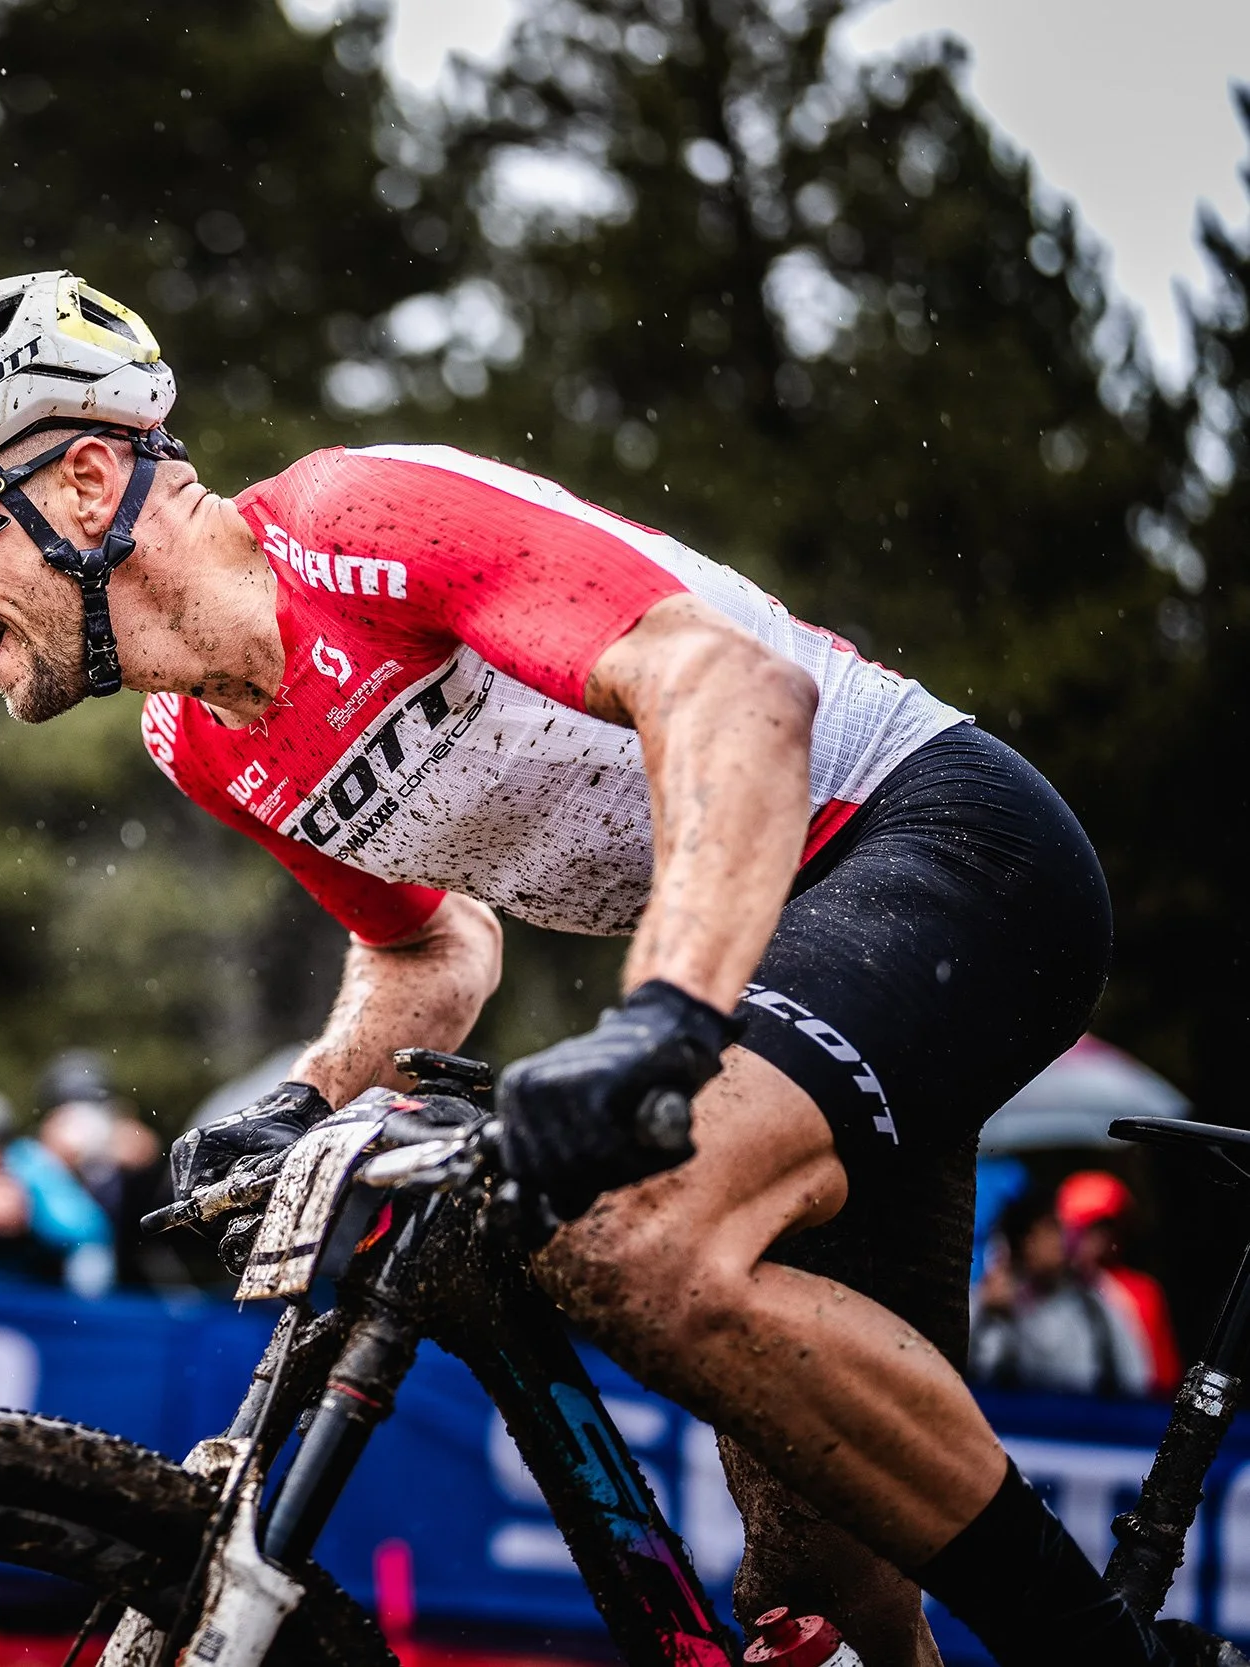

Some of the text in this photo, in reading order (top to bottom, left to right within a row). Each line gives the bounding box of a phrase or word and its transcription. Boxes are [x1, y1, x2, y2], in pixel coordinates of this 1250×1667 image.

[263, 523, 408, 600] SRAM
[326, 706, 339, 720] UCI
[329, 659, 398, 728] MOUNTAIN BIKE
[335, 665, 404, 731] WORLD SERIES
[230, 759, 269, 802] UCI
[346, 796, 400, 852] MAXXIS
